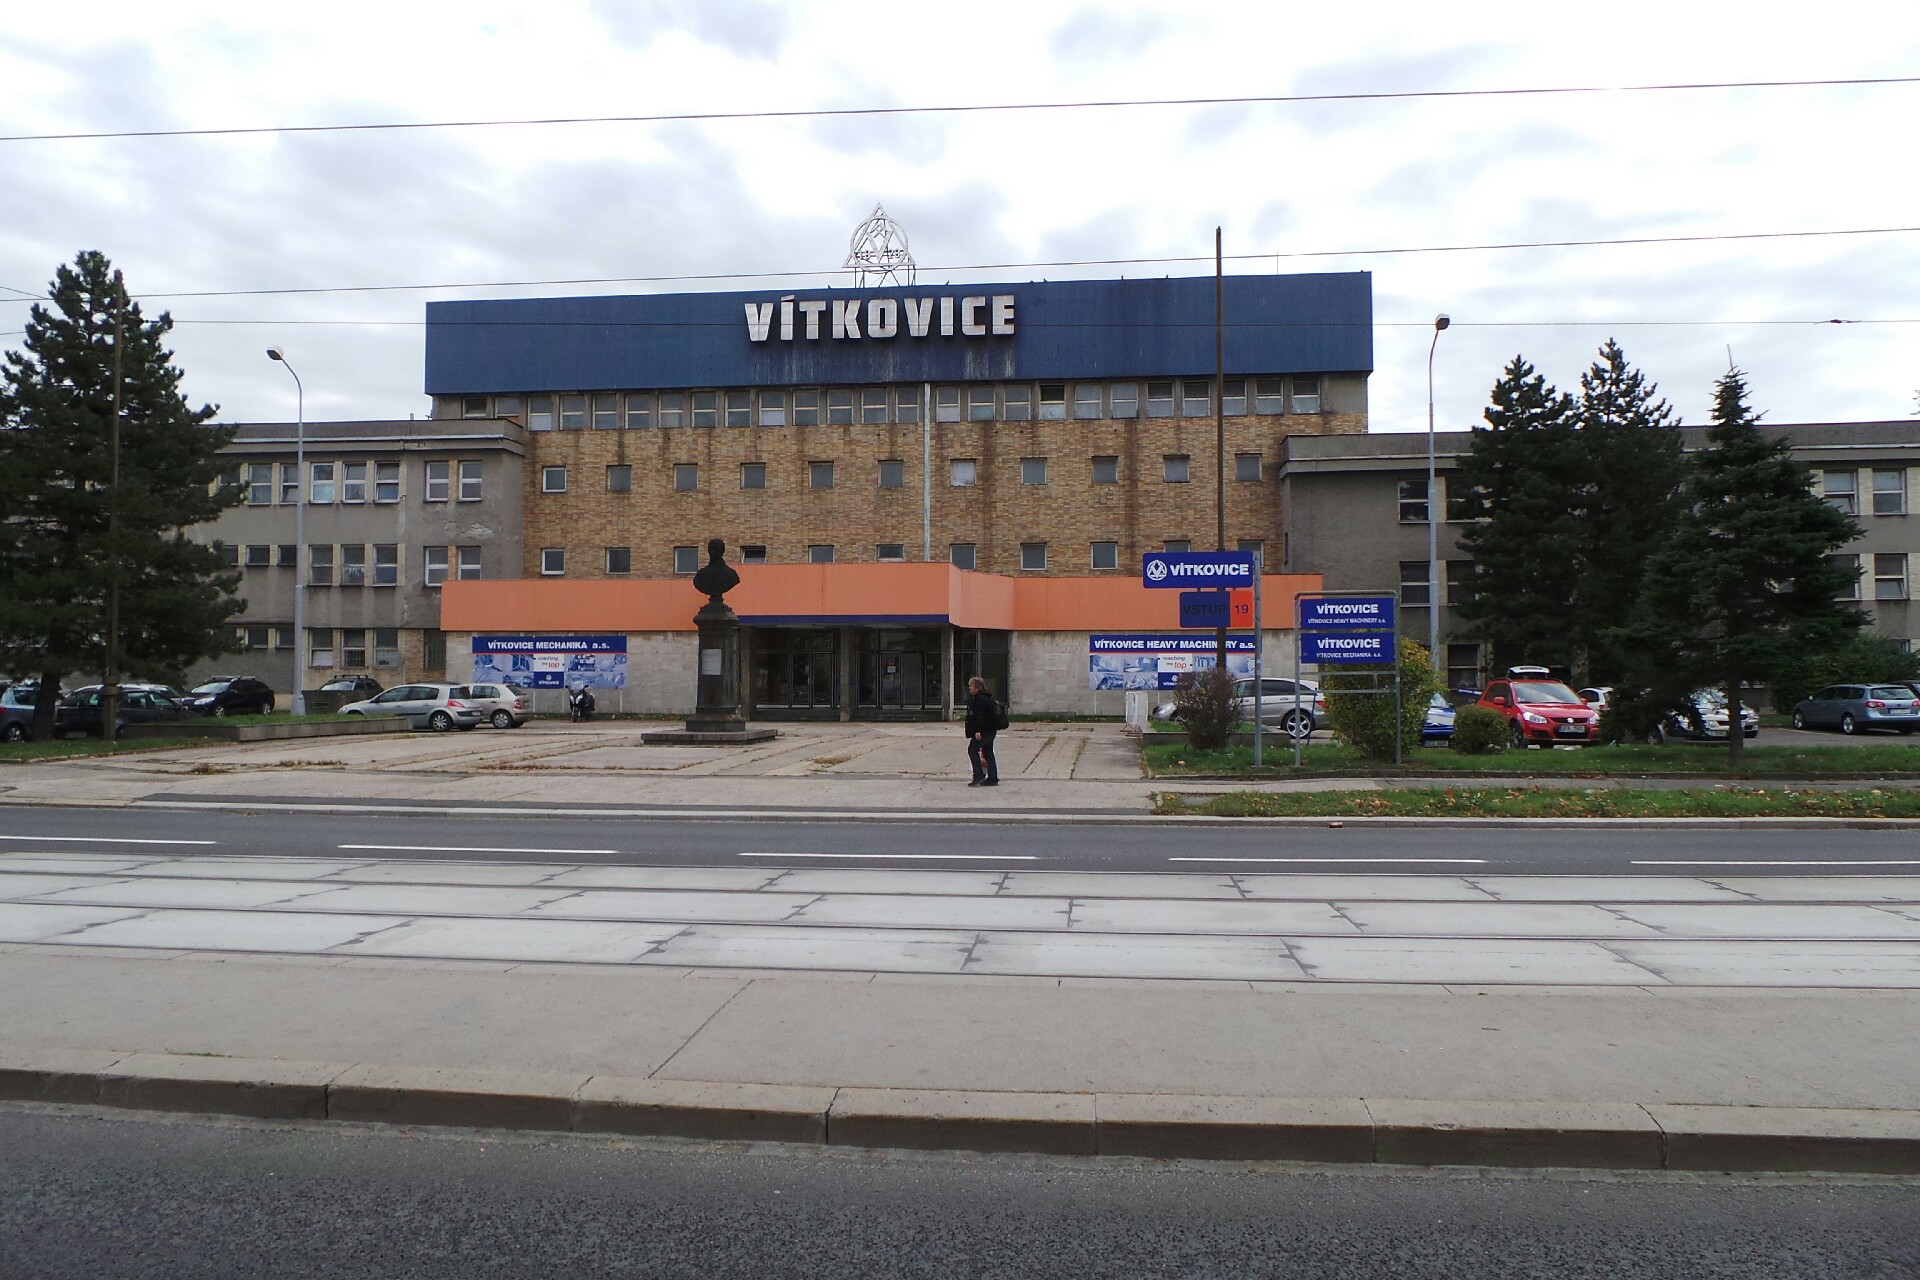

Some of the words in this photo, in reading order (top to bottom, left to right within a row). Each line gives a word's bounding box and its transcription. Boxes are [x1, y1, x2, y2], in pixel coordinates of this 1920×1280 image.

[744, 295, 1015, 342] VÍTKOVICE
[1170, 563, 1249, 576] VÍTKOVICE
[1184, 605, 1226, 614] VSTUP
[1235, 604, 1249, 614] 19
[1316, 603, 1379, 614] VÍTKOVICE
[488, 639, 534, 649] VÍTKOVICE
[535, 641, 588, 649] MECHANIKA
[1094, 639, 1145, 649] VÍTKOVICE
[1146, 640, 1177, 649] HEAVY
[1180, 640, 1238, 649] MACHINRY
[1317, 638, 1381, 649] VÍTKOVICE
